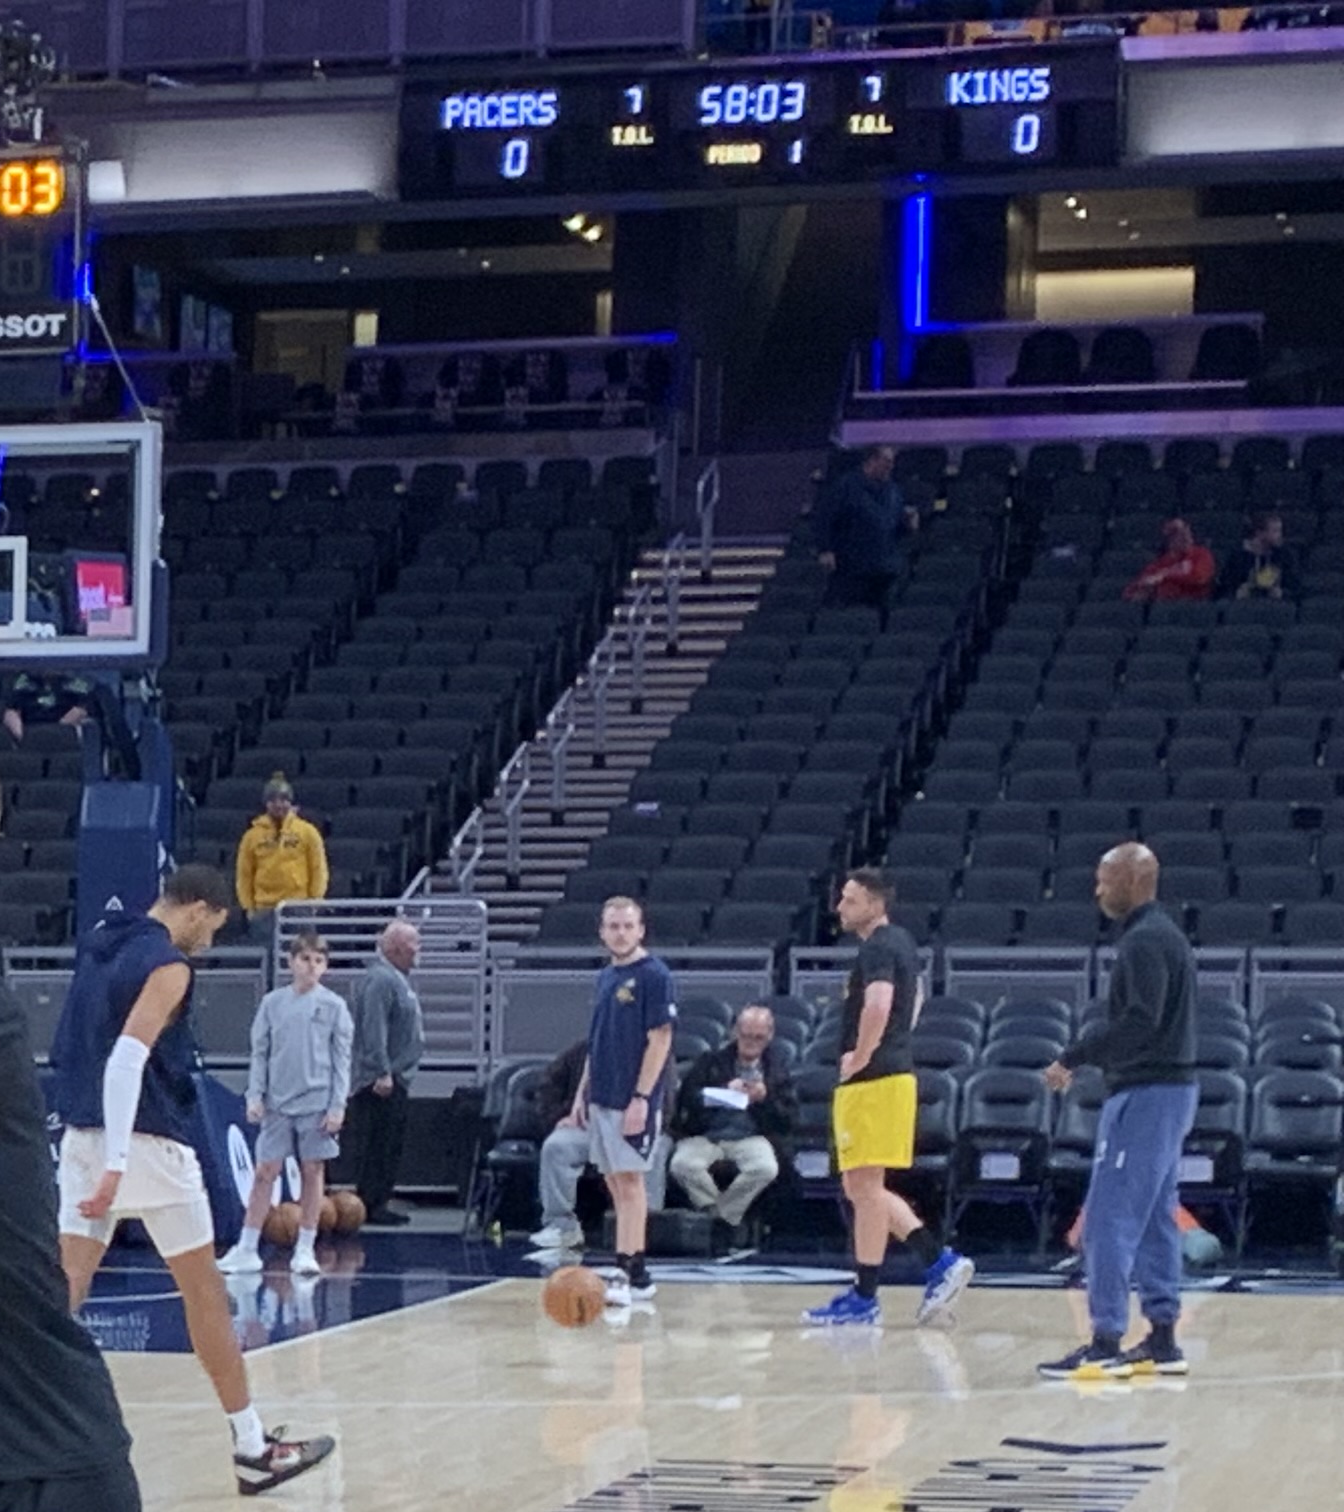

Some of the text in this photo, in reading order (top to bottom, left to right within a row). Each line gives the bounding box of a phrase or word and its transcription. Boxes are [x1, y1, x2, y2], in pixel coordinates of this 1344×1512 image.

[699, 81, 806, 127] 58:03
[948, 68, 1051, 106] KINGS
[443, 91, 558, 129] PACERS
[787, 139, 802, 164] 1
[1013, 113, 1040, 153] 0
[502, 139, 530, 179] 0
